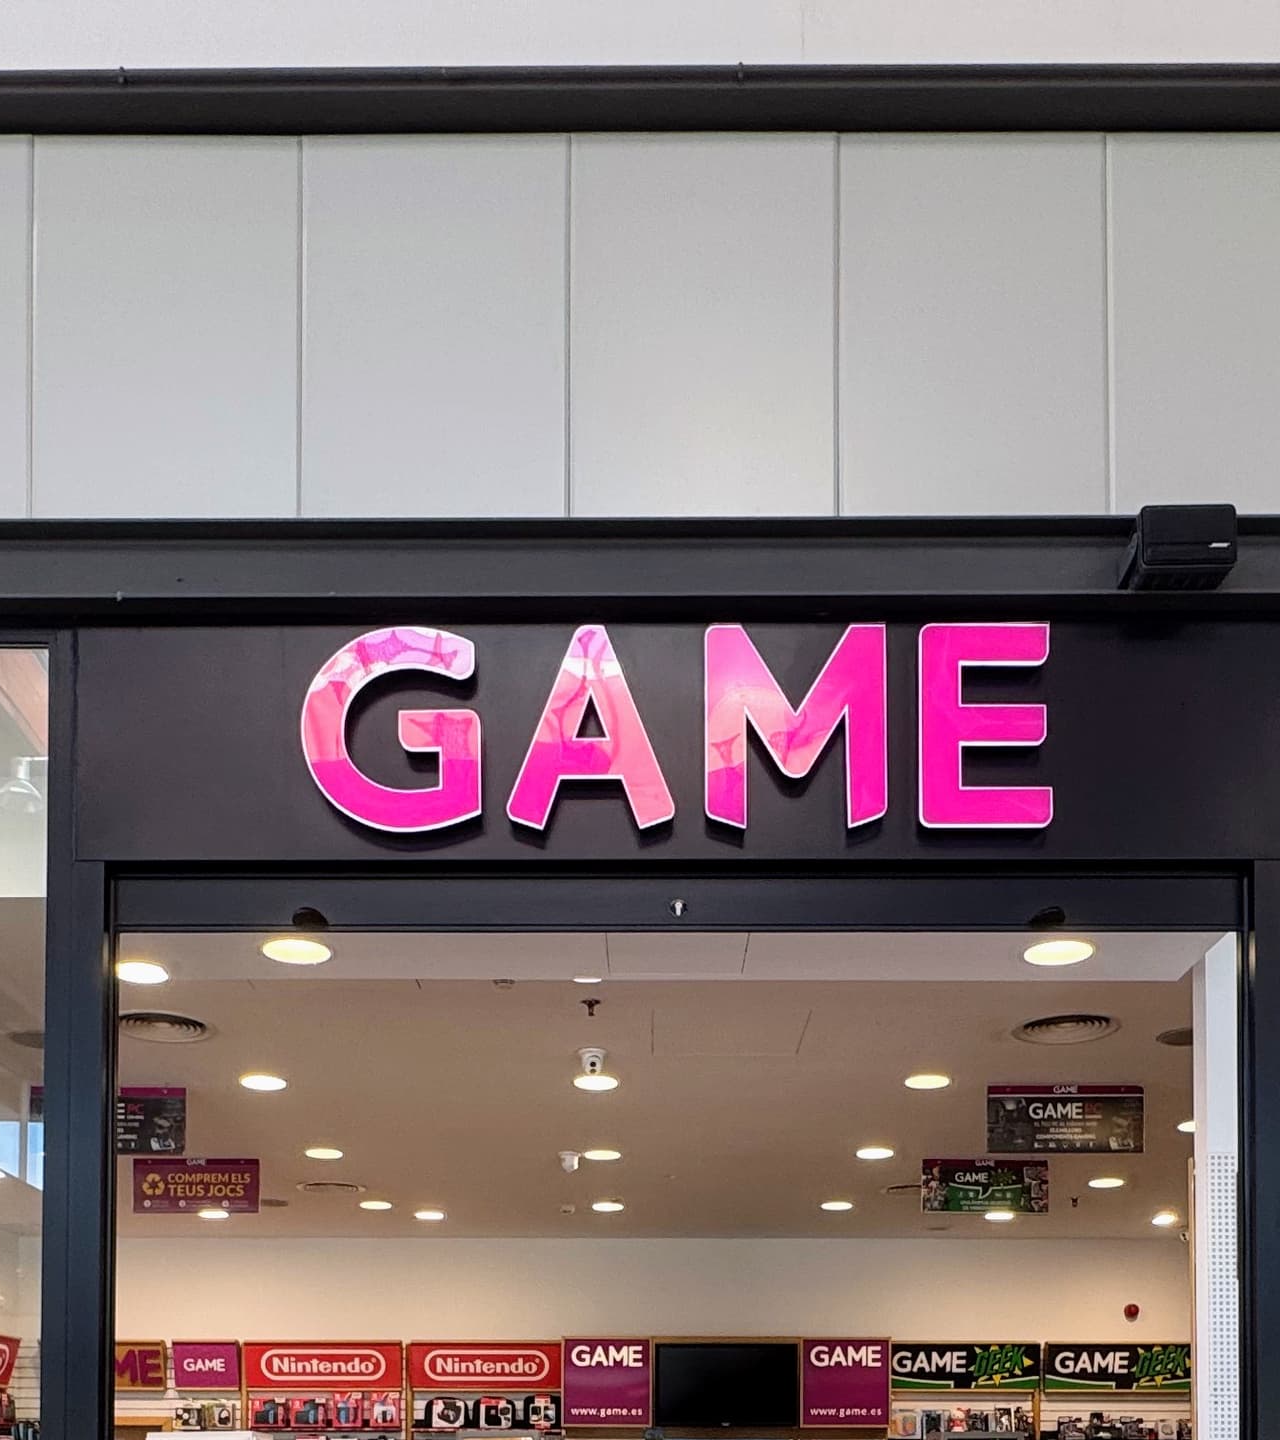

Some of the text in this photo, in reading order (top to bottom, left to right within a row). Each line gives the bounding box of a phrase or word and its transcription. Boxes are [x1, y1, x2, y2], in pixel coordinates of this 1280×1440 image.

[300, 620, 1053, 833] GAME
[1053, 1085, 1078, 1094] GAME
[1028, 1102, 1084, 1120] GAME
[168, 1173, 251, 1184] COMPREM ELS
[954, 1172, 989, 1184] GAME
[168, 1184, 245, 1197] TEUS JOCS
[183, 1358, 226, 1373] GAME
[272, 1356, 375, 1375] Nintendo
[435, 1355, 539, 1376] Nintendo
[570, 1345, 643, 1368] GAME
[809, 1345, 882, 1368] GAME
[891, 1347, 1026, 1378] GAME GEEK
[1054, 1347, 1188, 1379] GAME GEEK
[115, 1349, 164, 1386] ME
[570, 1407, 643, 1418] www.game.es
[809, 1407, 883, 1418] www.game.es
